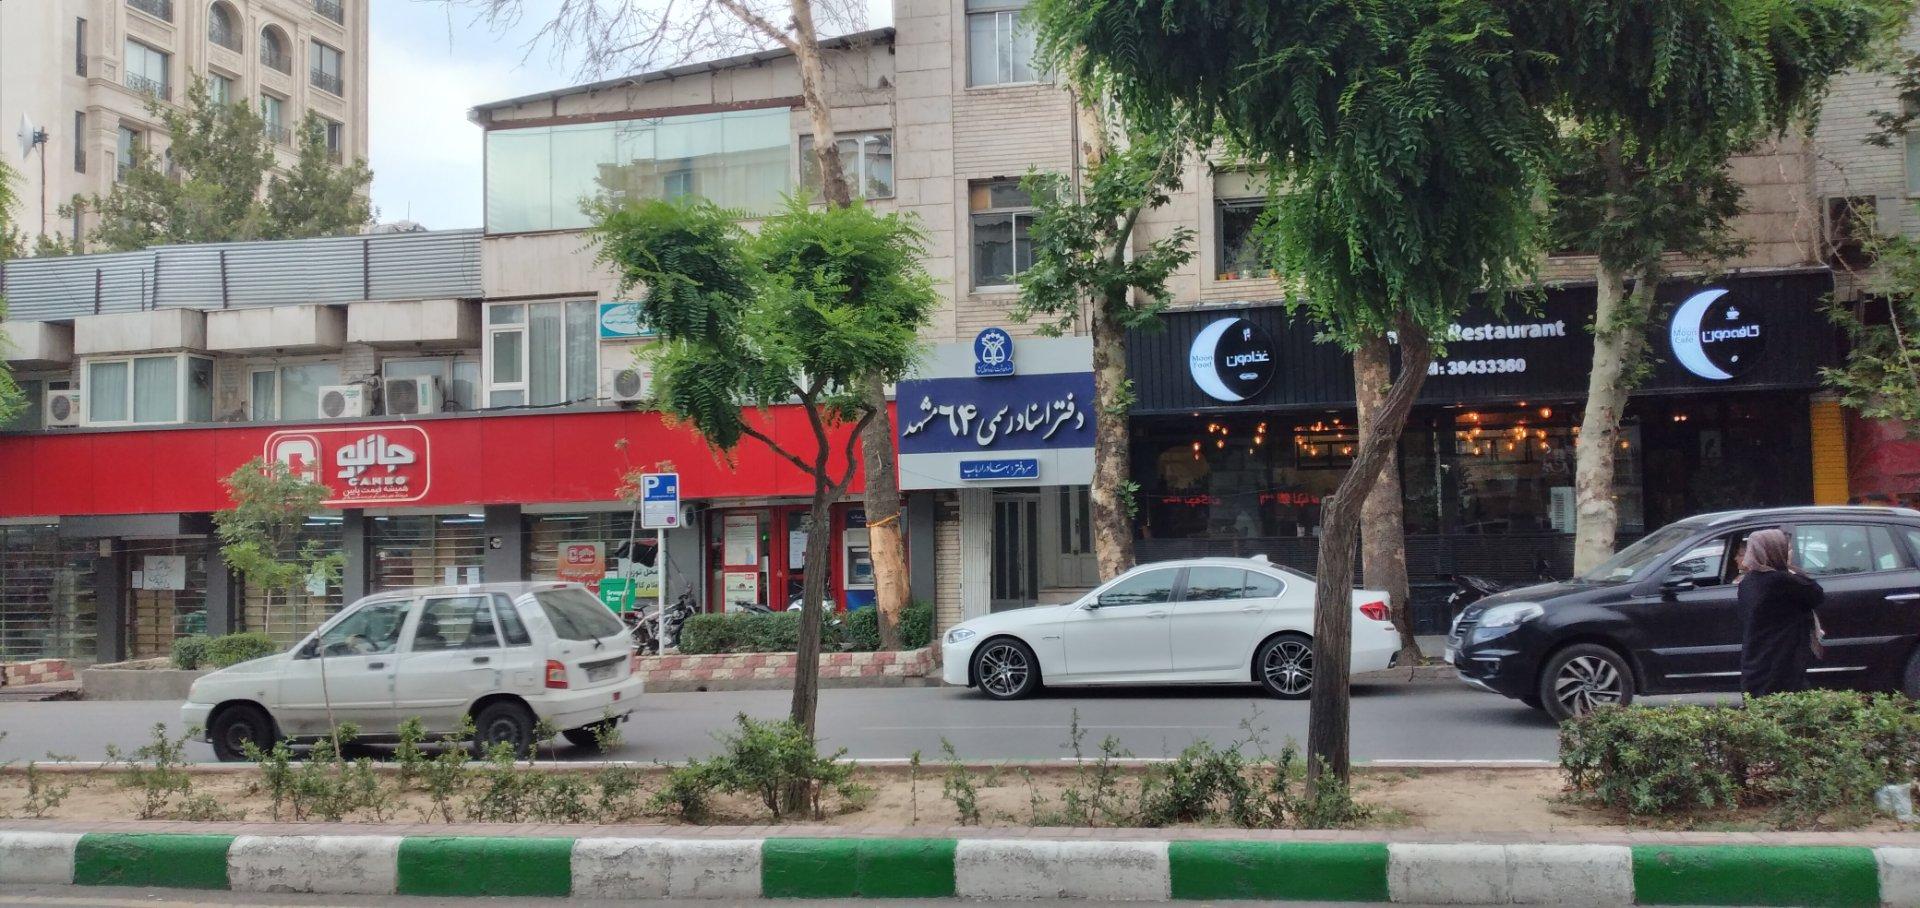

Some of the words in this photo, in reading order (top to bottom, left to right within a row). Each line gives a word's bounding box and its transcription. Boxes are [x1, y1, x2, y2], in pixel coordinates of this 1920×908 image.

[1447, 319, 1566, 342] Restaurant
[1193, 361, 1212, 369] Food
[1446, 357, 1526, 376] 38433360
[902, 396, 940, 437] مشهد
[976, 403, 1014, 446] رسمی
[1015, 401, 1050, 432] اسناد
[1042, 392, 1085, 440] دفتر
[361, 486, 382, 495] قیمت
[383, 485, 409, 494] همیشه
[644, 476, 660, 498] P
